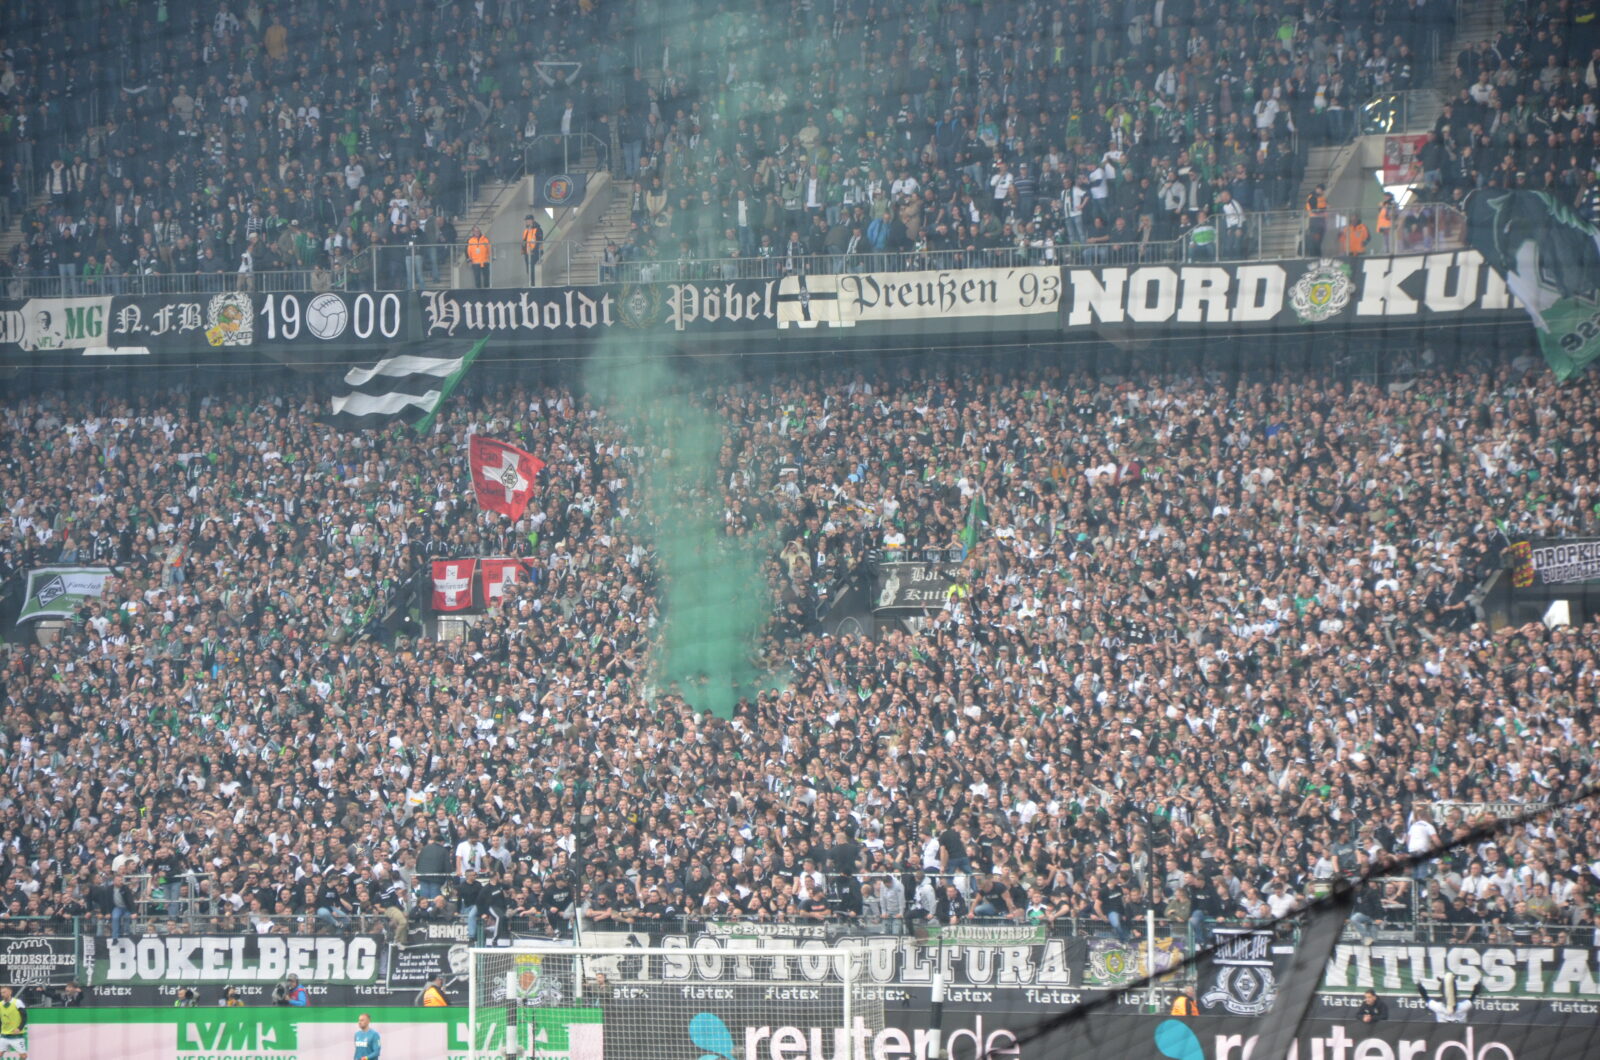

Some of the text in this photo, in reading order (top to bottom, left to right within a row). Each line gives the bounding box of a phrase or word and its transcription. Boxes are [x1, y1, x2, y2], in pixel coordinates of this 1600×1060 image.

[841, 273, 999, 315] Preußen
[1068, 264, 1287, 326] NORD
[665, 279, 776, 331] Pöbel
[421, 290, 615, 336] Humboldt
[64, 305, 103, 339] MG
[941, 925, 1038, 940] STADIONVERBOT
[93, 985, 132, 996] flatex
[682, 986, 734, 999] flatex
[851, 988, 905, 1001] flatex
[1026, 990, 1081, 1003] flatex
[1475, 999, 1520, 1012] flatex
[1551, 1001, 1599, 1013] flatex
